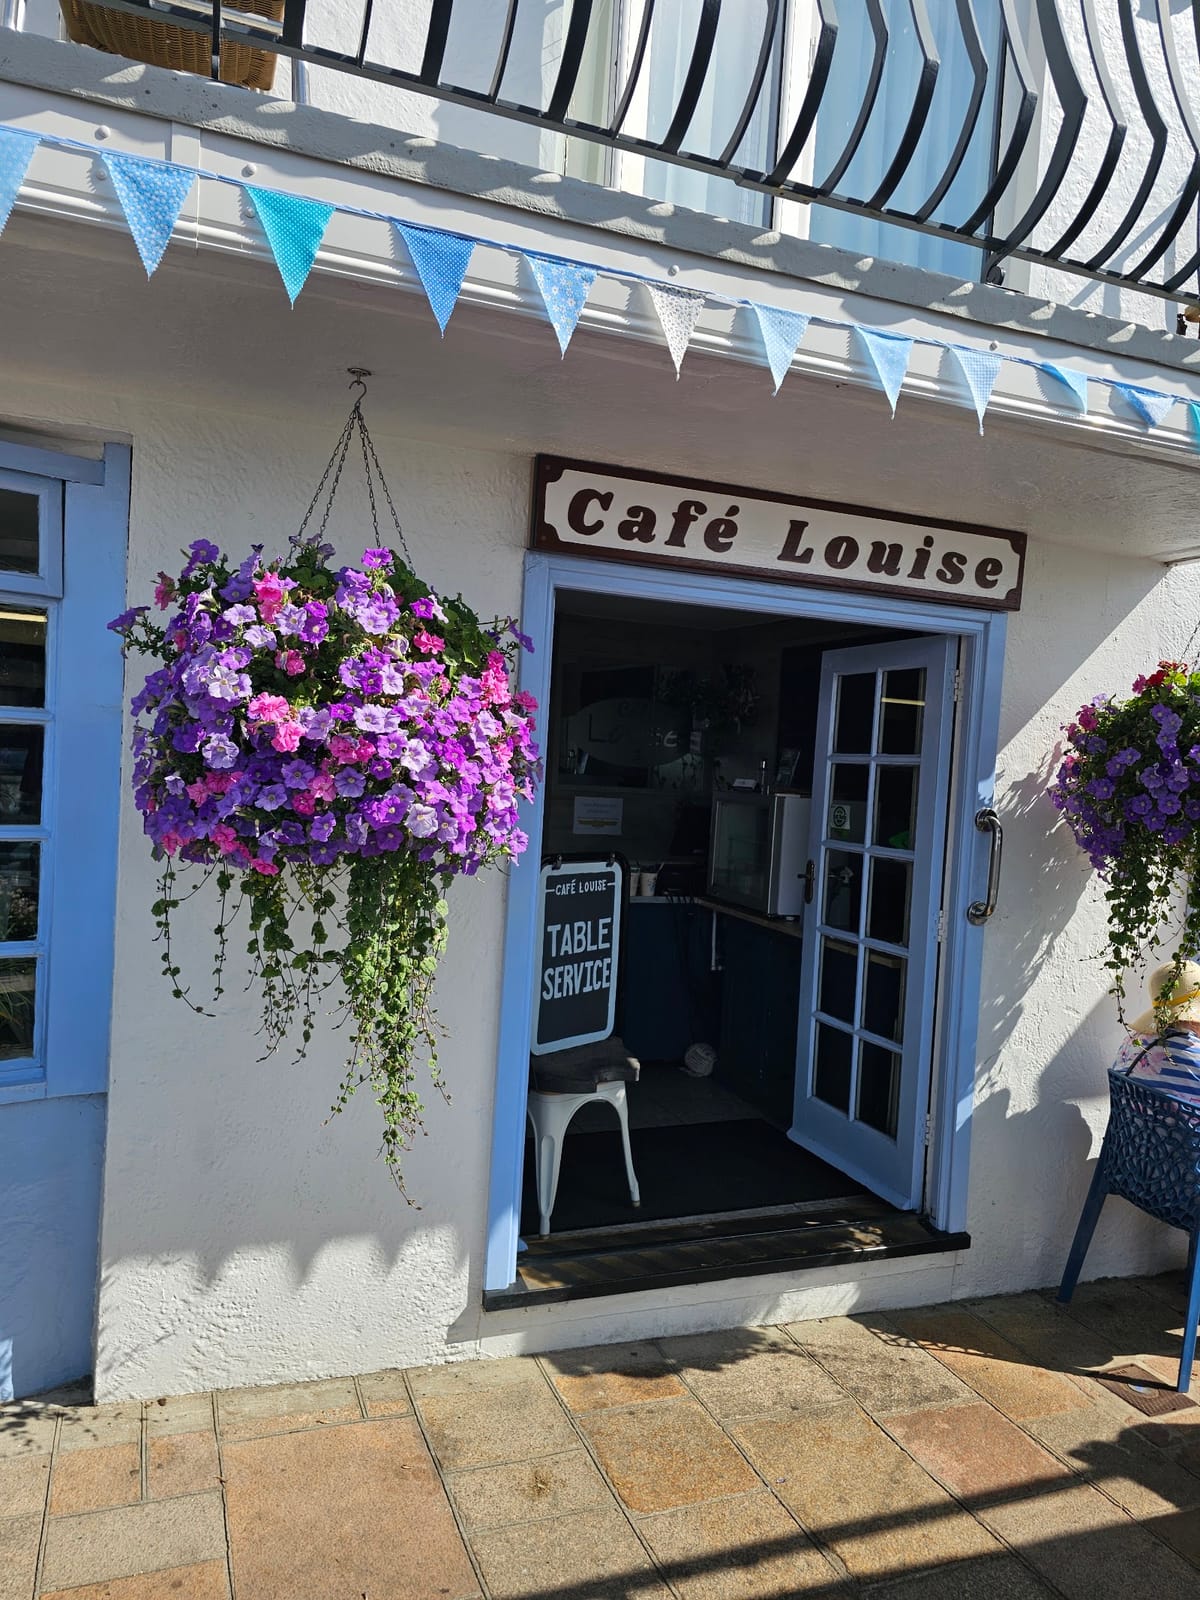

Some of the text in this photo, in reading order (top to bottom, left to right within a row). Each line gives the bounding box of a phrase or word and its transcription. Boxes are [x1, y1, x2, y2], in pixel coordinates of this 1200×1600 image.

[567, 488, 1003, 589] Café Louise
[555, 879, 607, 896] CAFÉ LOUISE
[547, 917, 612, 958] TABLE
[542, 957, 611, 1001] SERVICE
